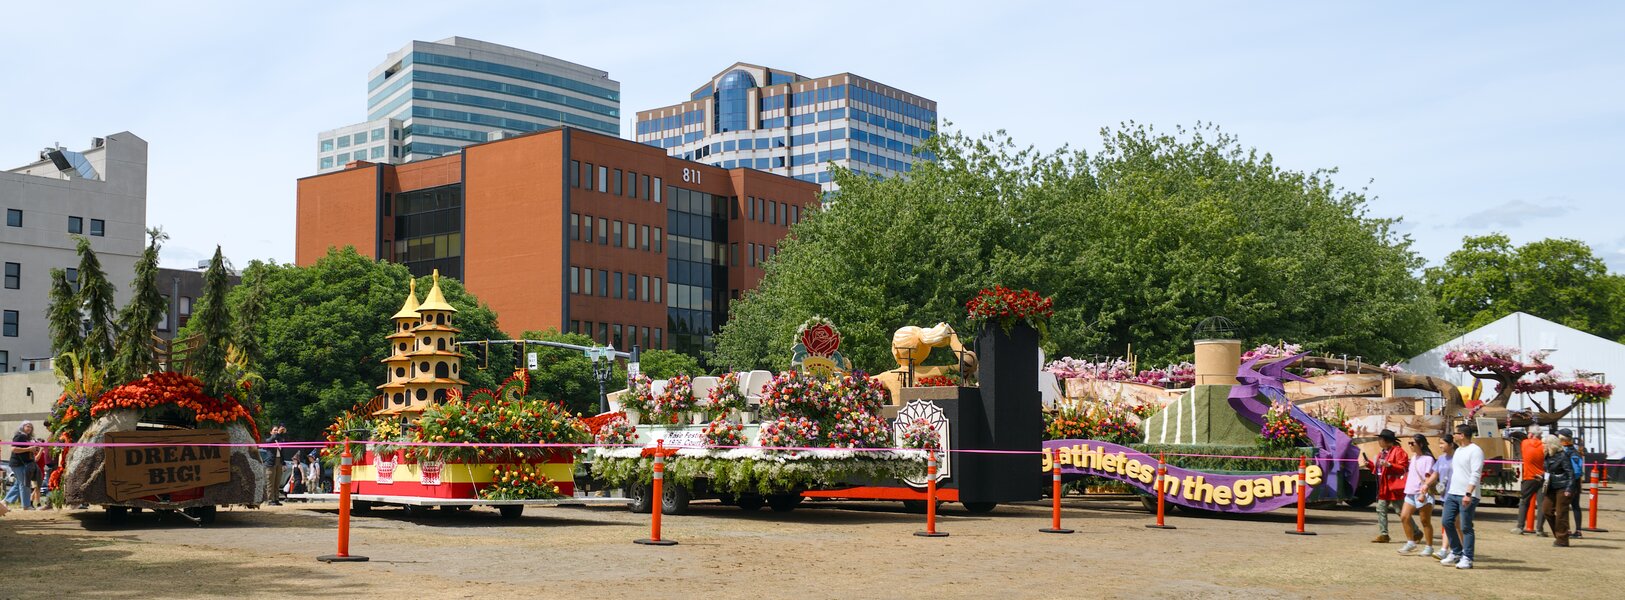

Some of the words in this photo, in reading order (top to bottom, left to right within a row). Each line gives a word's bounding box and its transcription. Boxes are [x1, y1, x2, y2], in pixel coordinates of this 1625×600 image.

[683, 168, 701, 184] 811
[125, 446, 221, 466] DREAM
[148, 465, 201, 485] BIG!
[1058, 443, 1156, 484] athletes
[1182, 475, 1233, 506] the
[1232, 464, 1323, 506] game
